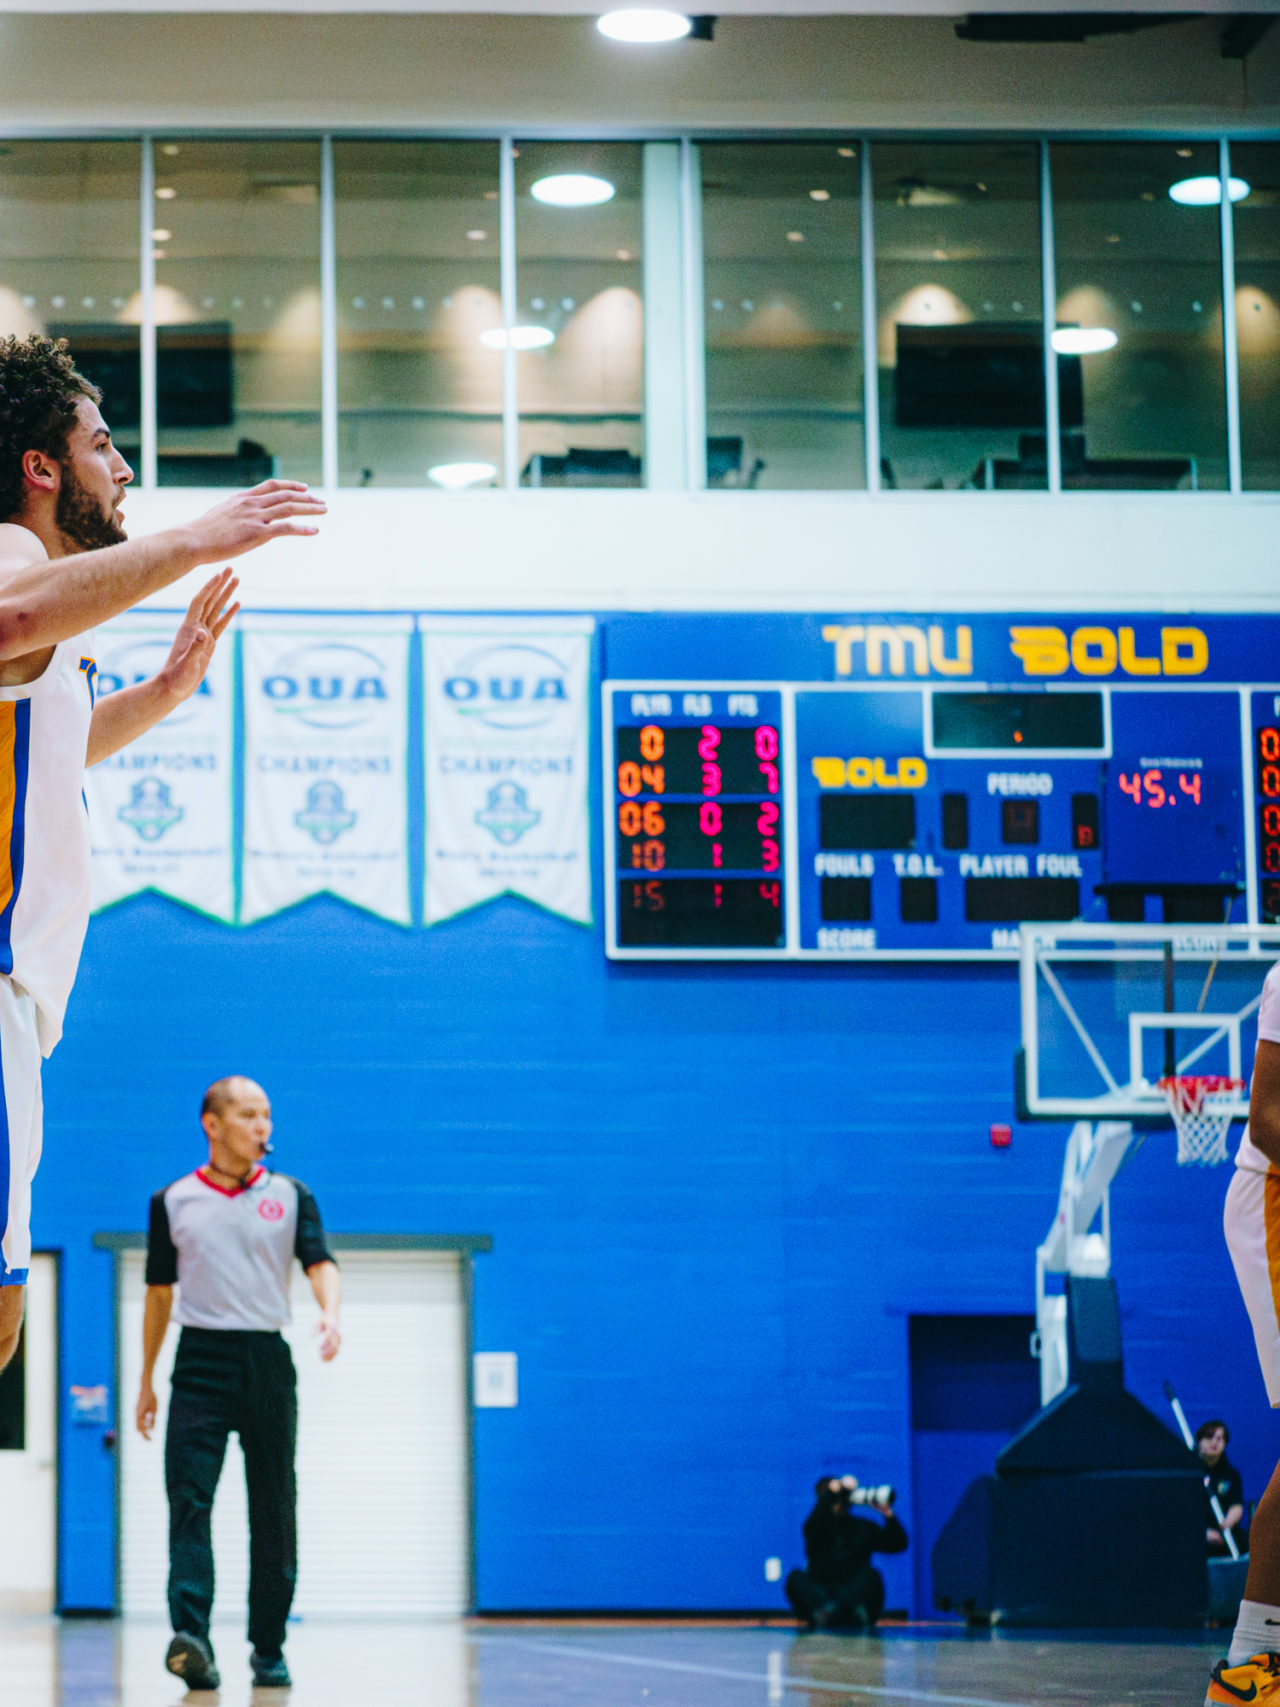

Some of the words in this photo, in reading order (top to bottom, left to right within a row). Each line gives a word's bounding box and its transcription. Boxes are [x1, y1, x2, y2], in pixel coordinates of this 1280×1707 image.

[822, 625, 973, 676] TMU
[1010, 626, 1209, 676] BOLD
[262, 676, 388, 700] OUA
[443, 677, 569, 701] OUA
[640, 725, 664, 761] 0
[698, 725, 720, 761] 2
[754, 726, 778, 761] 0
[257, 756, 392, 774] CHAMPIONS
[440, 757, 573, 775] CHAMPIONS
[618, 761, 665, 797] 04
[701, 762, 722, 797] 3
[759, 762, 779, 794] 7
[812, 757, 927, 788] BOLD
[1119, 770, 1201, 808] 45.4
[619, 801, 666, 836] 06
[699, 801, 722, 837] 0
[757, 801, 779, 836] 2
[632, 839, 666, 872] 10
[712, 843, 723, 868] 1
[762, 839, 780, 872] 3
[814, 854, 875, 877] FOULS
[959, 855, 1029, 877] PLAYER
[1036, 855, 1083, 877] FOUL
[759, 882, 779, 908] 4
